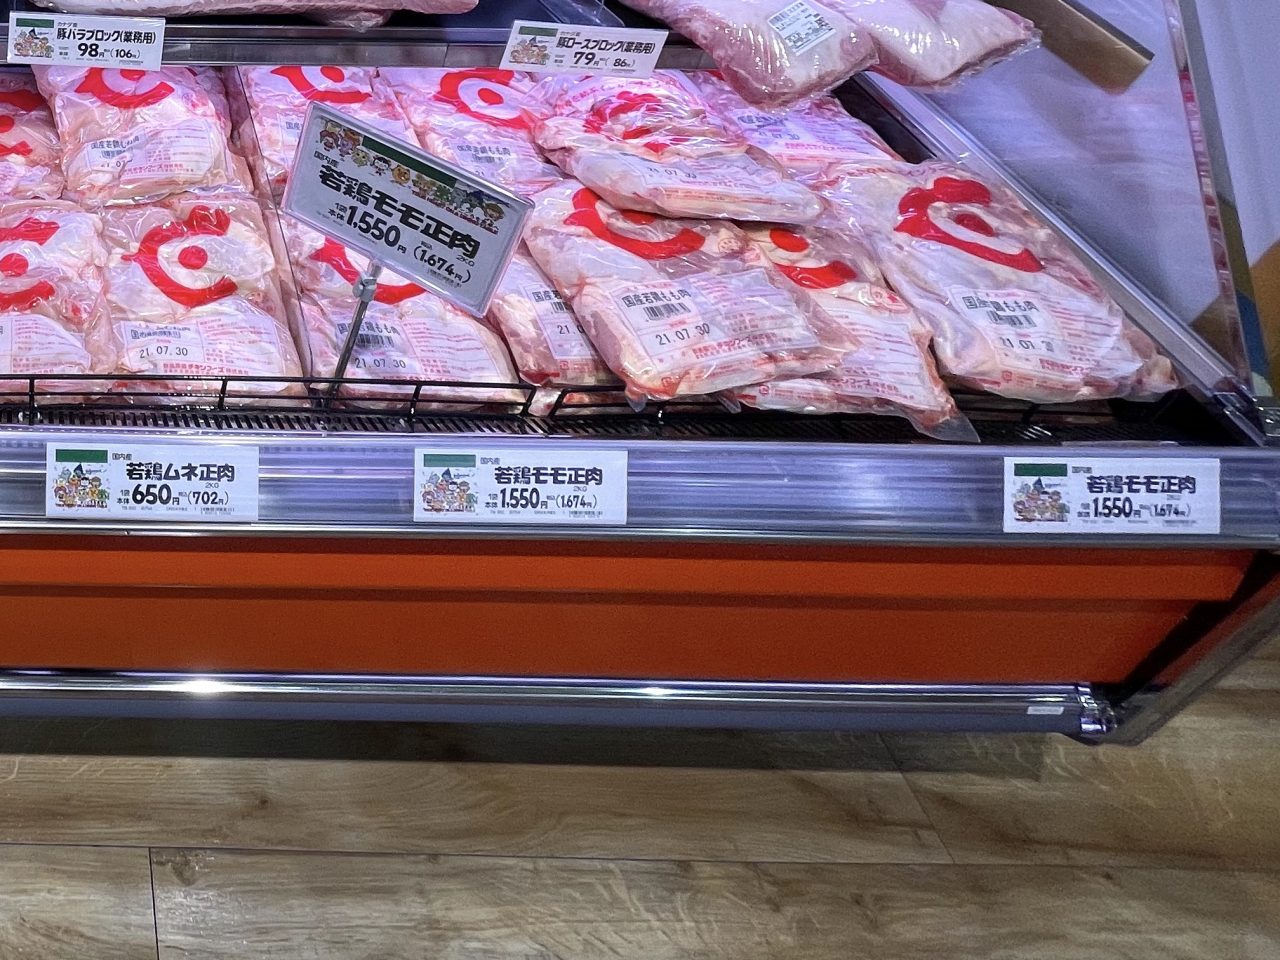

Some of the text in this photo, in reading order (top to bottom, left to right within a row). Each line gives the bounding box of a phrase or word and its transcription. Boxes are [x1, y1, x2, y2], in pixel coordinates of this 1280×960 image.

[319, 163, 481, 259] 若鶏モモ正肉
[622, 289, 692, 308] 国産若鶏もも肉
[125, 461, 236, 482] 若鶏ムネ正肉
[494, 466, 603, 486] 若鶏モモ正肉
[1086, 475, 1196, 494] 若鶏モモ正肉
